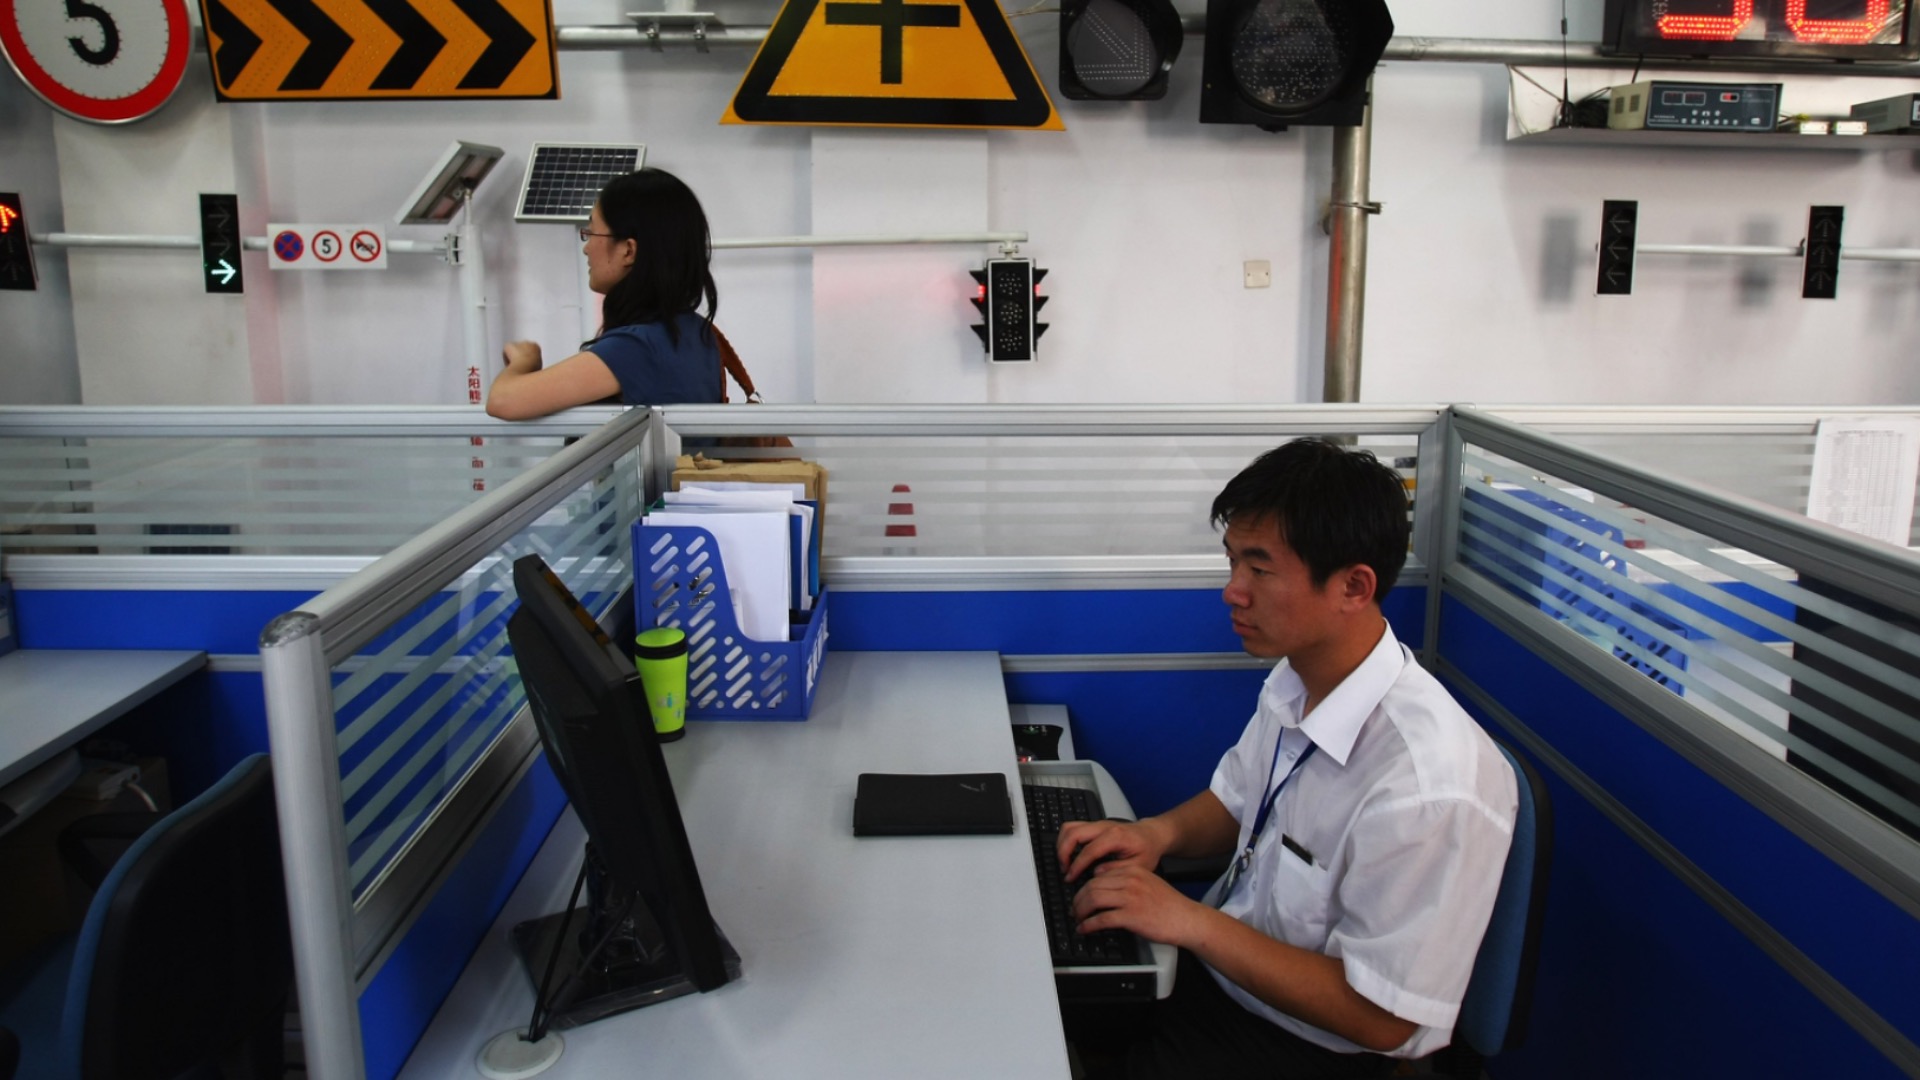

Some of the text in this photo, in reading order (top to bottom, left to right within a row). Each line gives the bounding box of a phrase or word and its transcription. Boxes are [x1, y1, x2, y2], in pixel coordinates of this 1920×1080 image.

[66, 0, 119, 65] 5
[322, 239, 331, 254] 5
[467, 366, 481, 404] 太阳能
